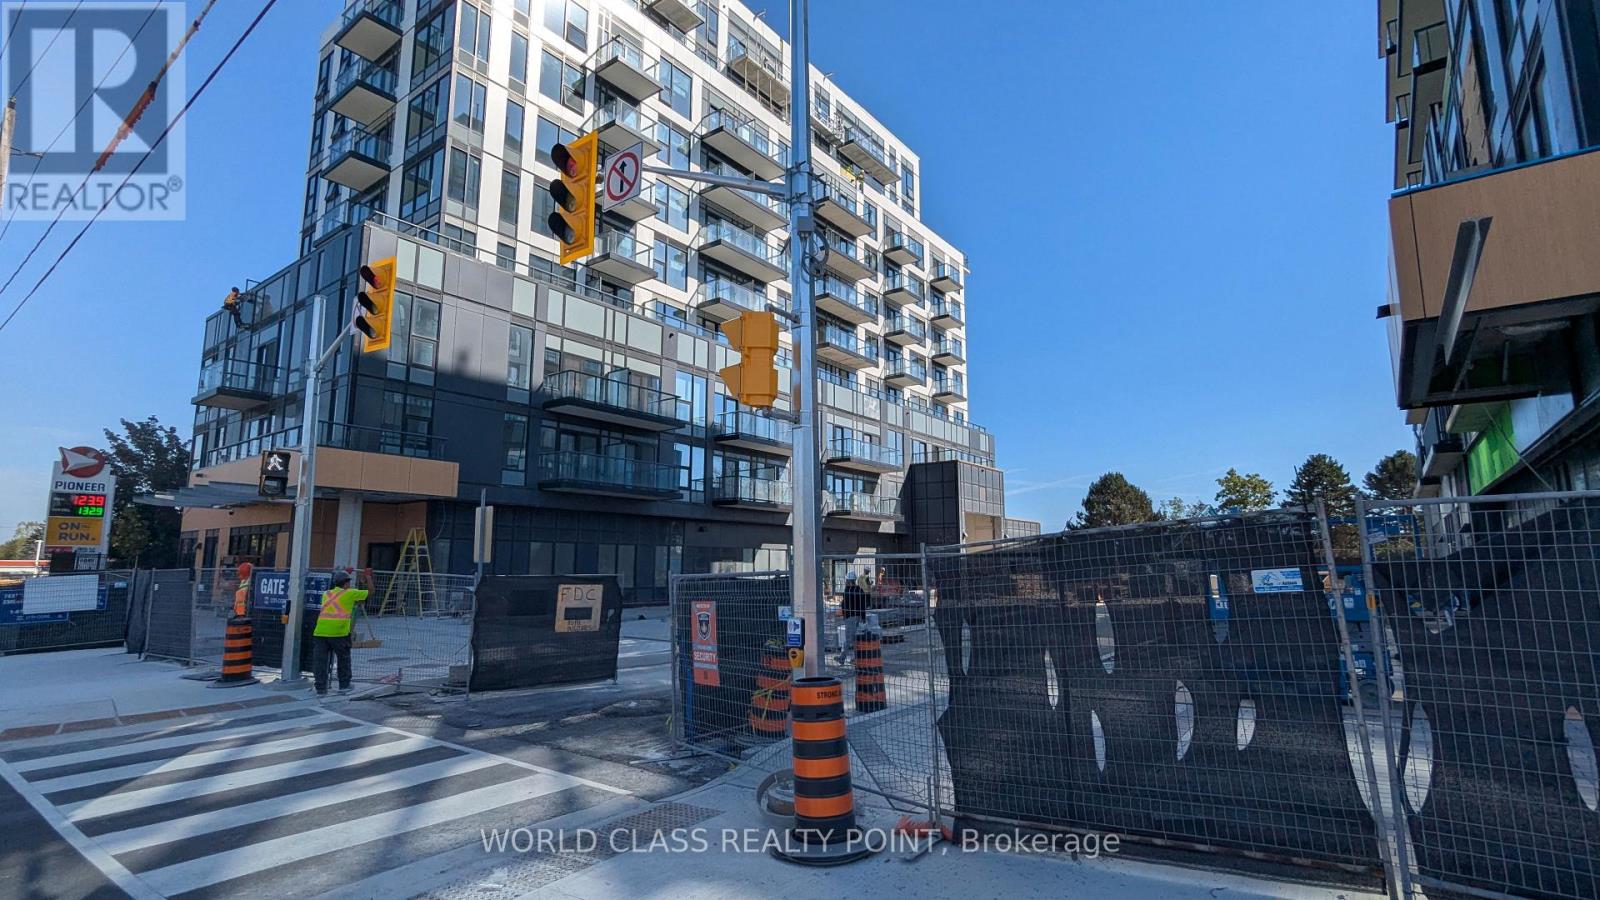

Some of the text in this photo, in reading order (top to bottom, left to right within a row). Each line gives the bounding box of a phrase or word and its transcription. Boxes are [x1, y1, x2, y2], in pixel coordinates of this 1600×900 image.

[54, 480, 106, 492] PIONEER
[58, 522, 80, 530] ON
[58, 532, 90, 541] RUN
[260, 578, 286, 595] GATE
